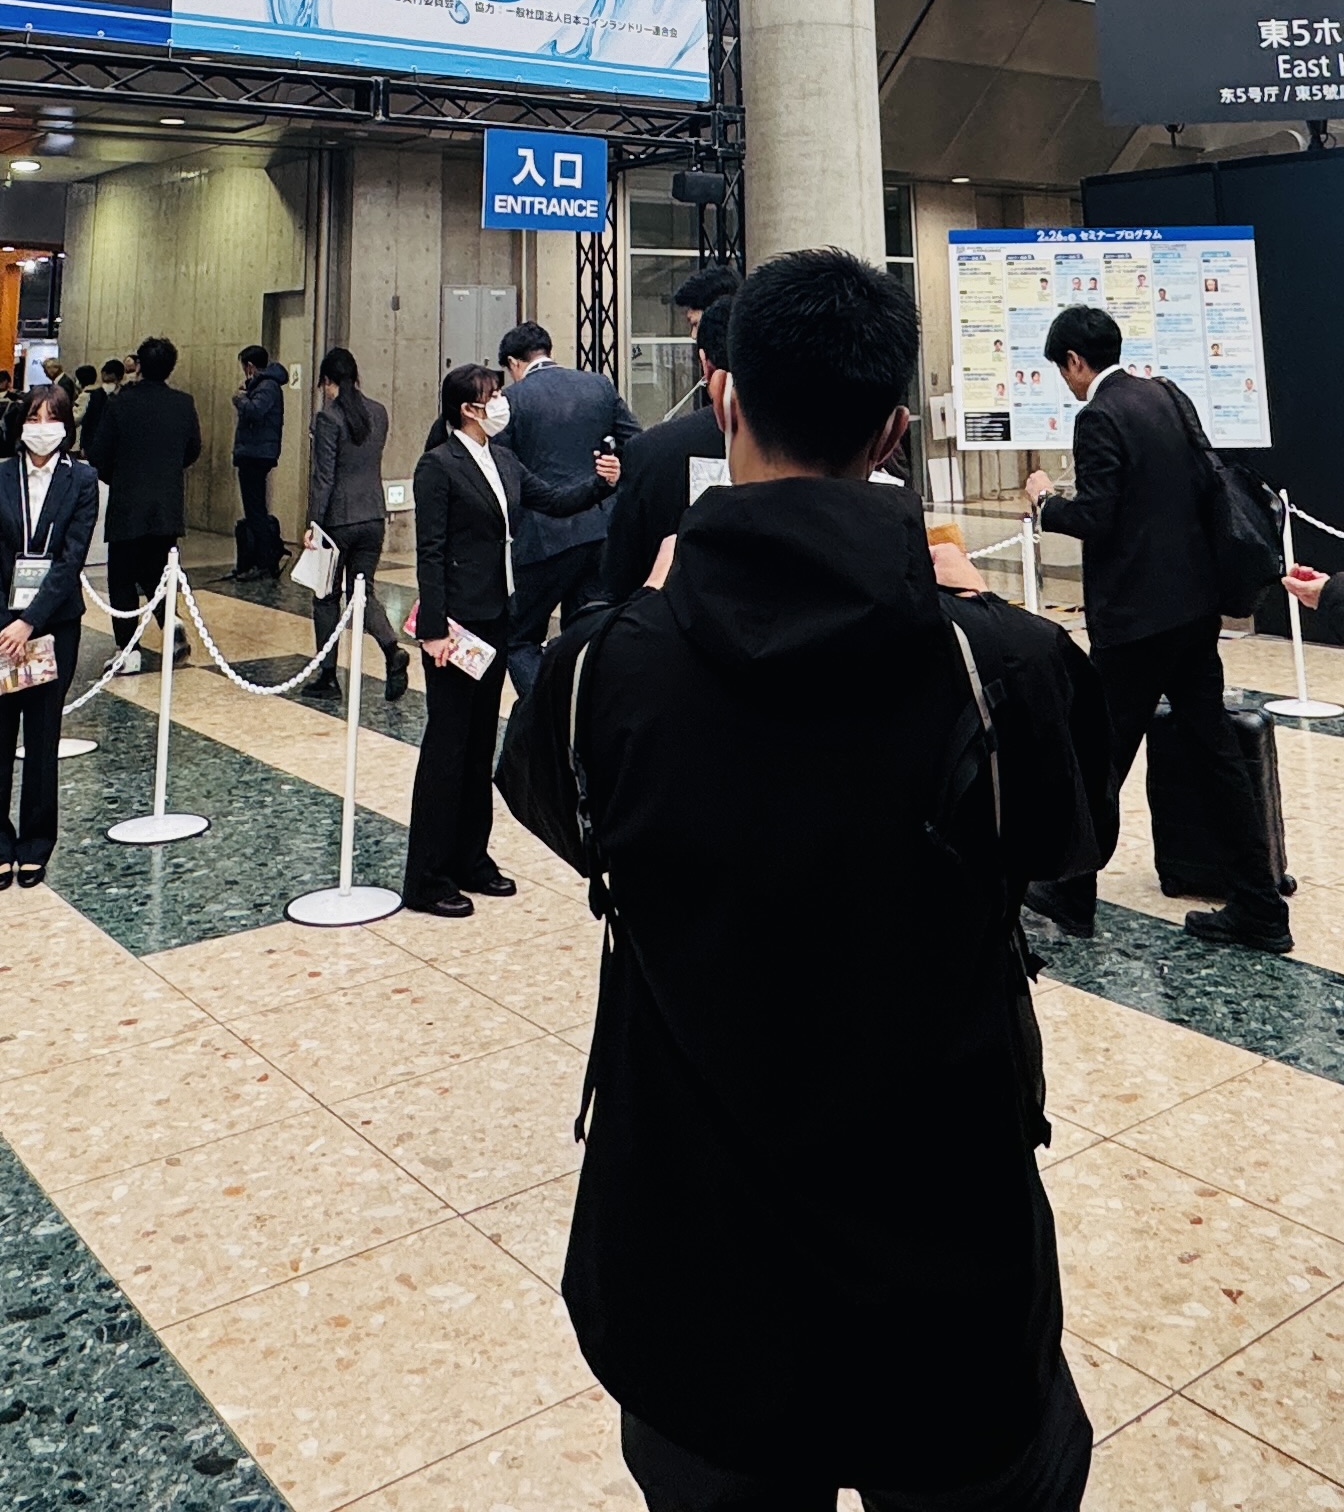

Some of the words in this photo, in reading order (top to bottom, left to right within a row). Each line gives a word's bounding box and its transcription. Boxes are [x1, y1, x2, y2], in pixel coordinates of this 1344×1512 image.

[1277, 55, 1331, 78] East
[512, 148, 583, 189] 入口
[494, 194, 599, 218] ENTRANCE
[1079, 229, 1163, 241] セミナープログラム
